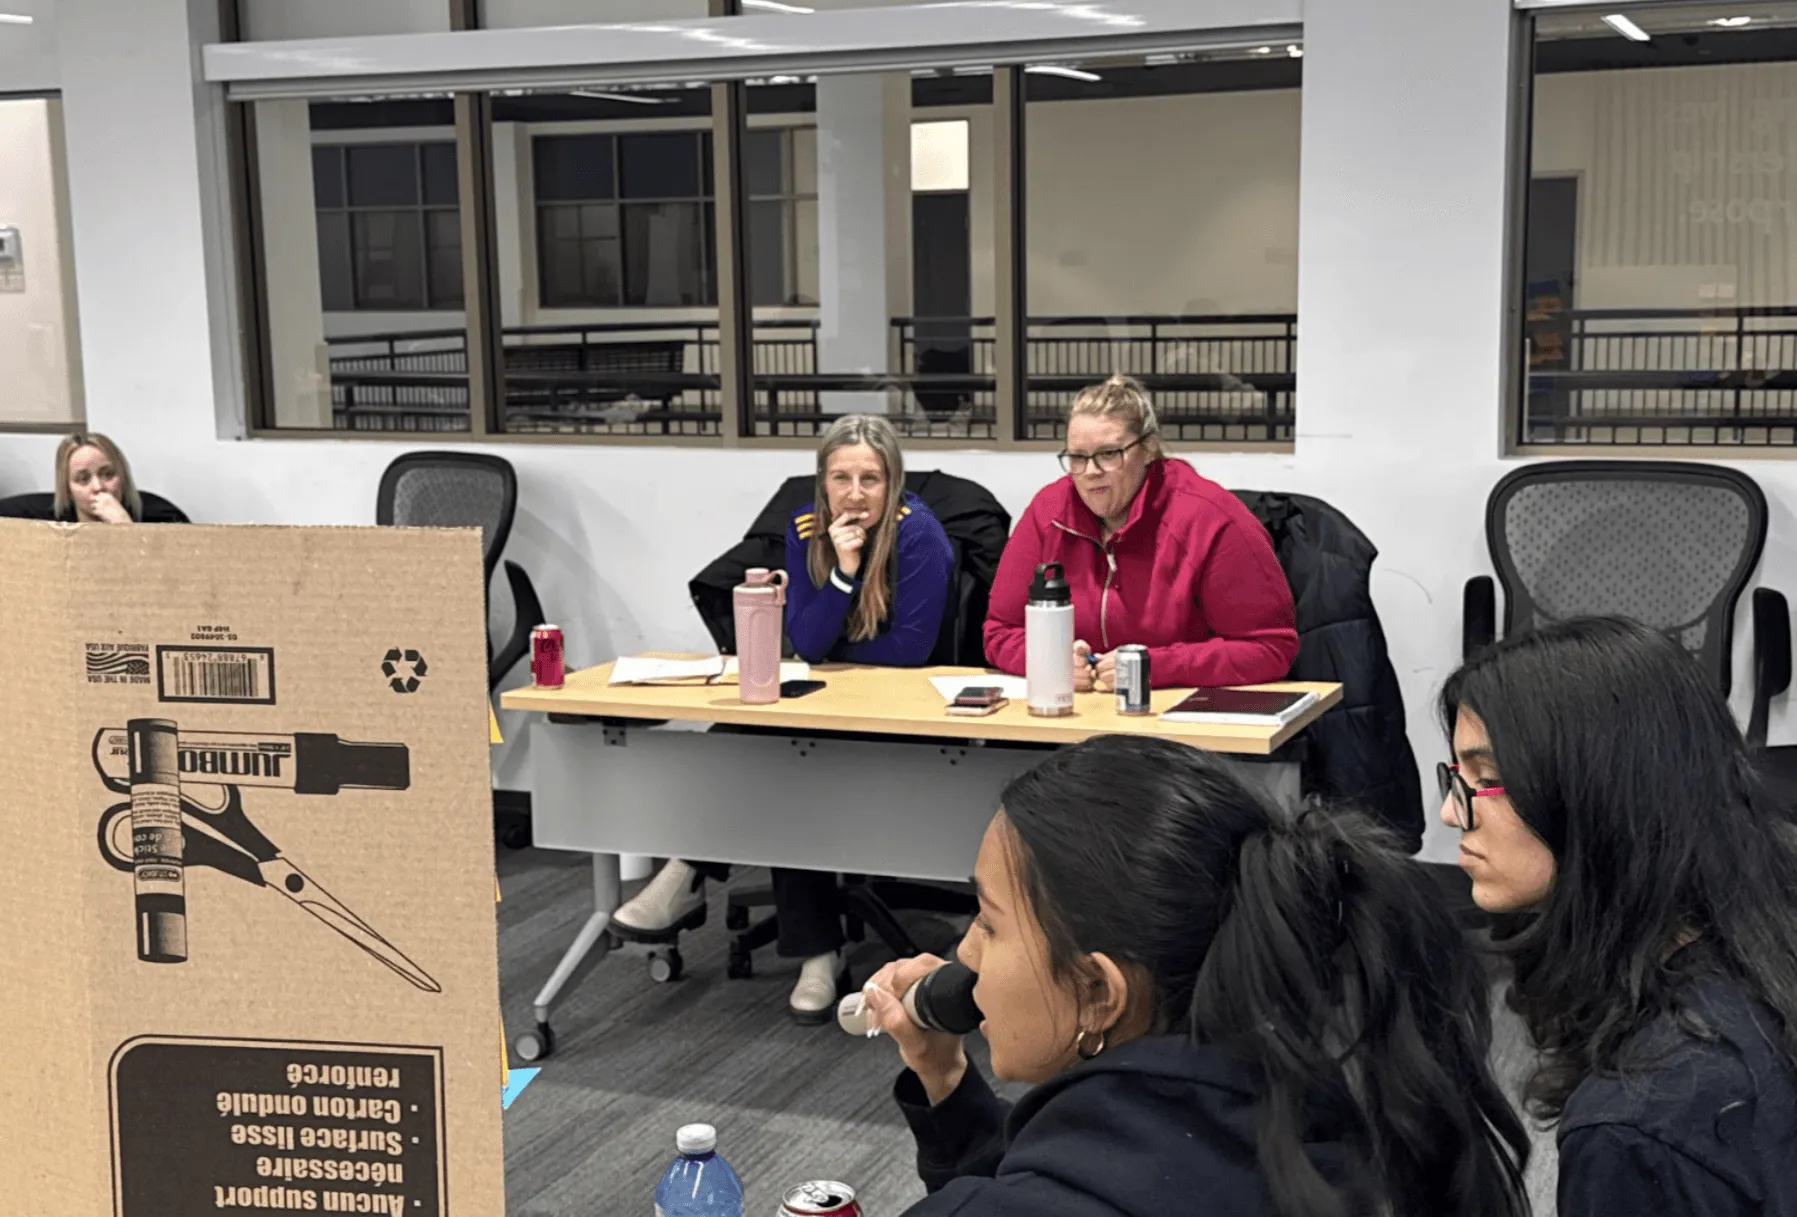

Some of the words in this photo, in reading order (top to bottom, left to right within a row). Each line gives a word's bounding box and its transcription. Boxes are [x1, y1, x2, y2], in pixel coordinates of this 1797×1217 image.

[88, 675, 102, 684] USA
[104, 676, 118, 684] THE
[120, 676, 127, 684] IN
[130, 676, 151, 684] MADE
[178, 751, 291, 777] JUMBO
[286, 1063, 400, 1088] renforcé
[216, 1092, 307, 1117] ondulé
[313, 1096, 401, 1124] Carton
[231, 1124, 295, 1150] lisse
[300, 1127, 403, 1155] Surface
[256, 1157, 404, 1187] nécessaire
[215, 1186, 317, 1211] support
[323, 1191, 404, 1217] Aucun
